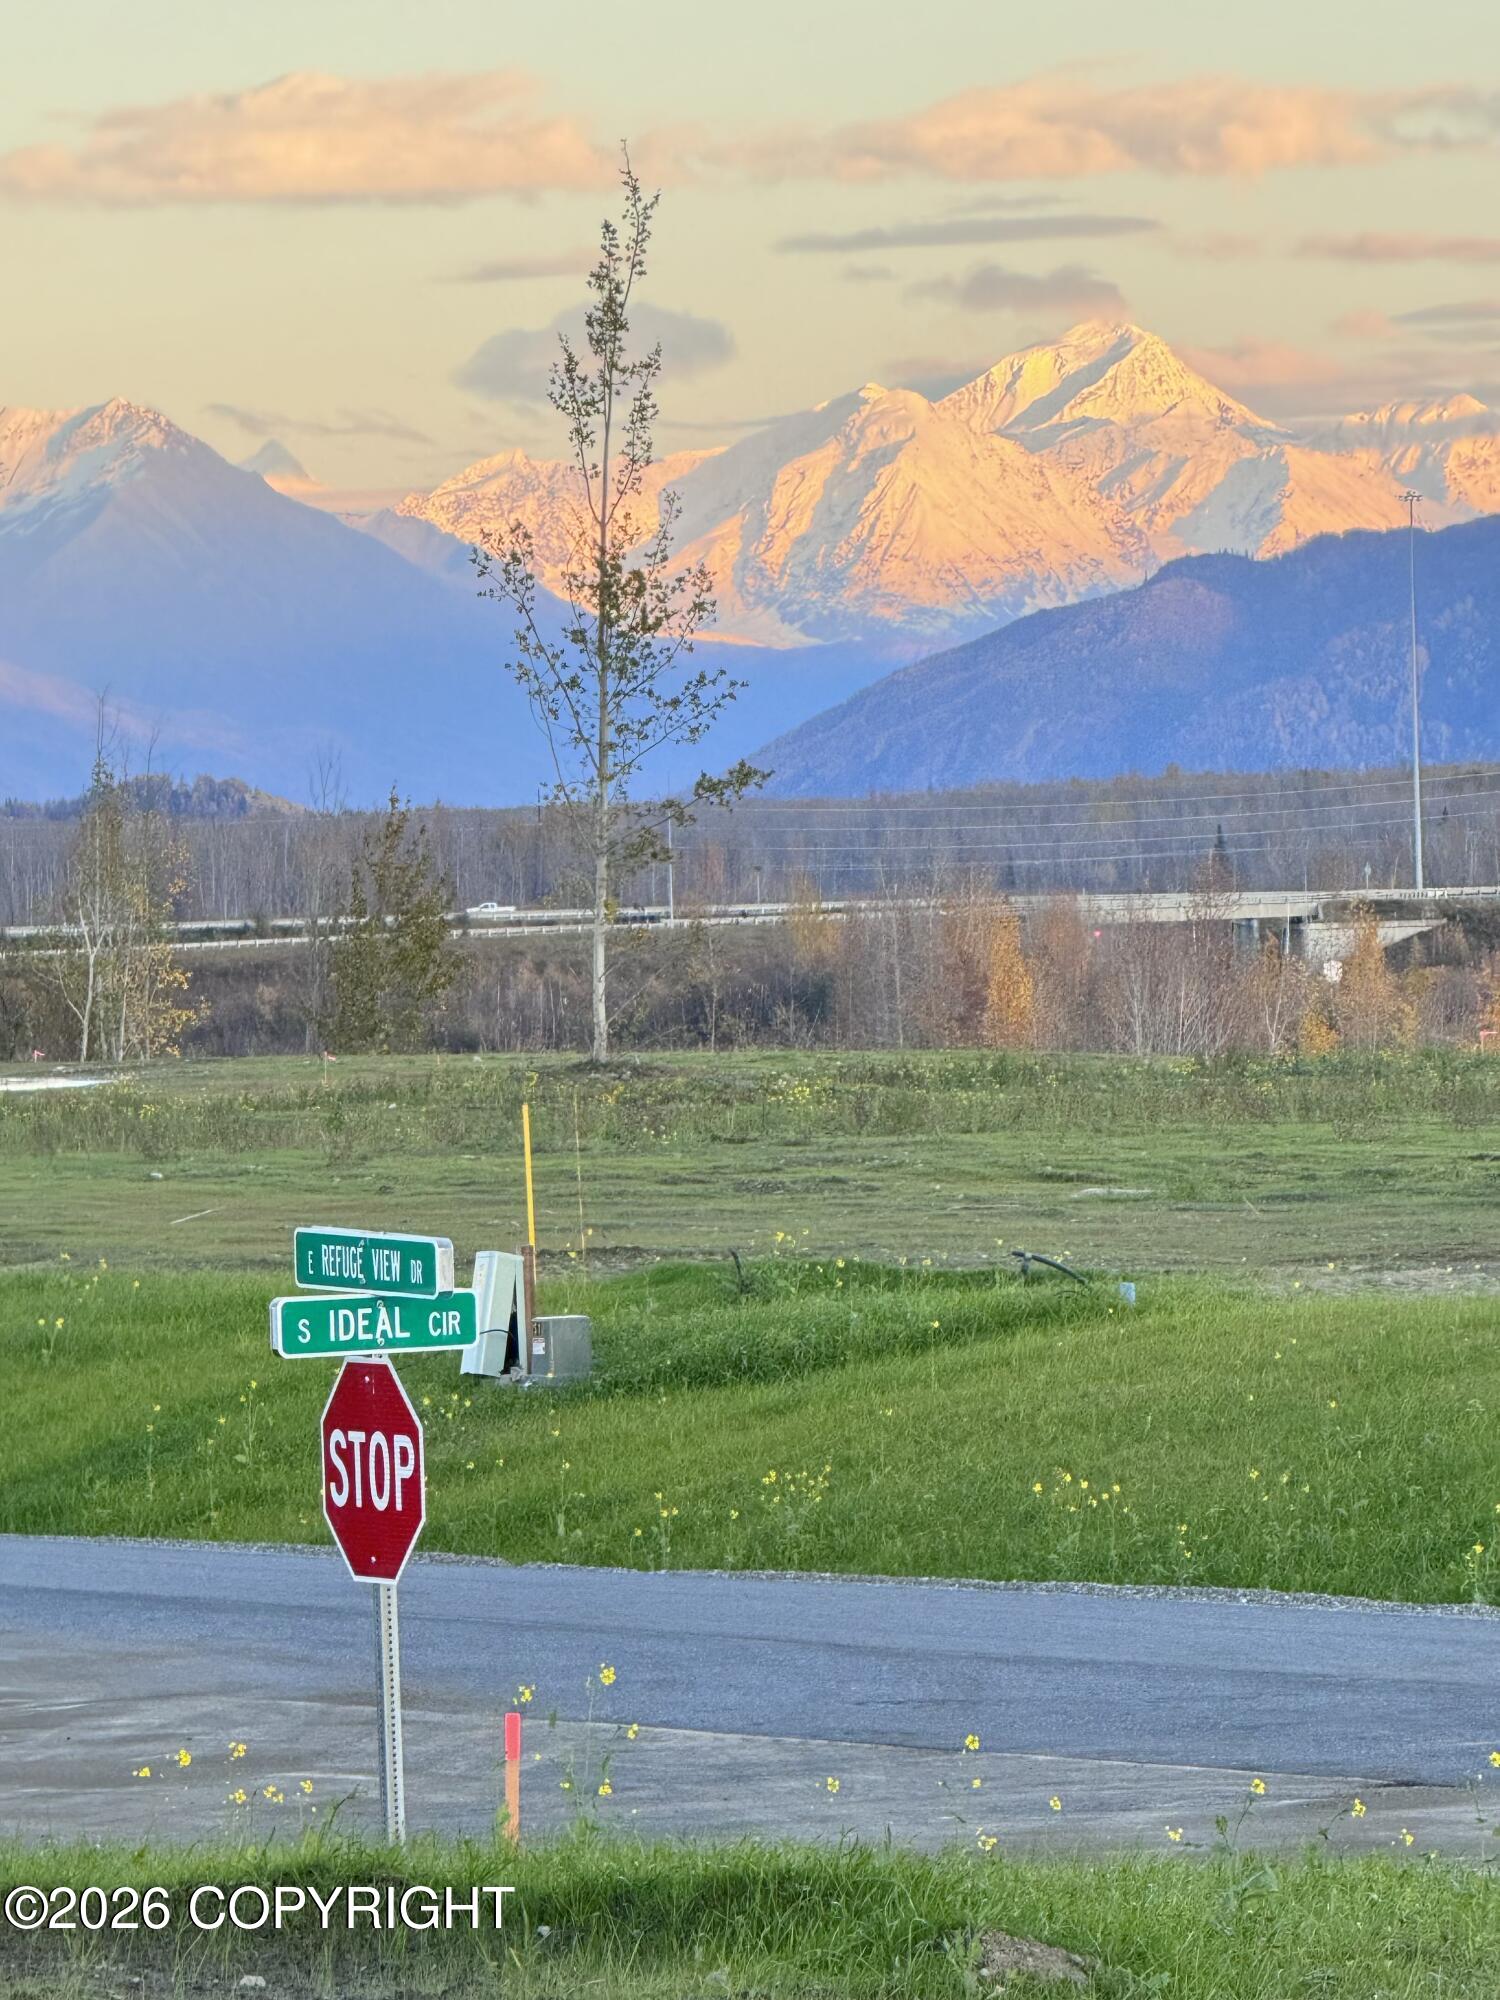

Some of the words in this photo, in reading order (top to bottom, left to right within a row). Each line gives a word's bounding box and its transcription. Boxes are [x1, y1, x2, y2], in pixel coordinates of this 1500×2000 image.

[308, 1250, 314, 1275] E
[321, 1244, 364, 1279] REFUGE
[371, 1248, 401, 1282] VIEW
[410, 1259, 423, 1285] DR
[297, 1318, 311, 1344] S
[329, 1306, 411, 1342] IDEAL
[428, 1310, 461, 1337] CIR
[329, 1428, 415, 1512] STOP
